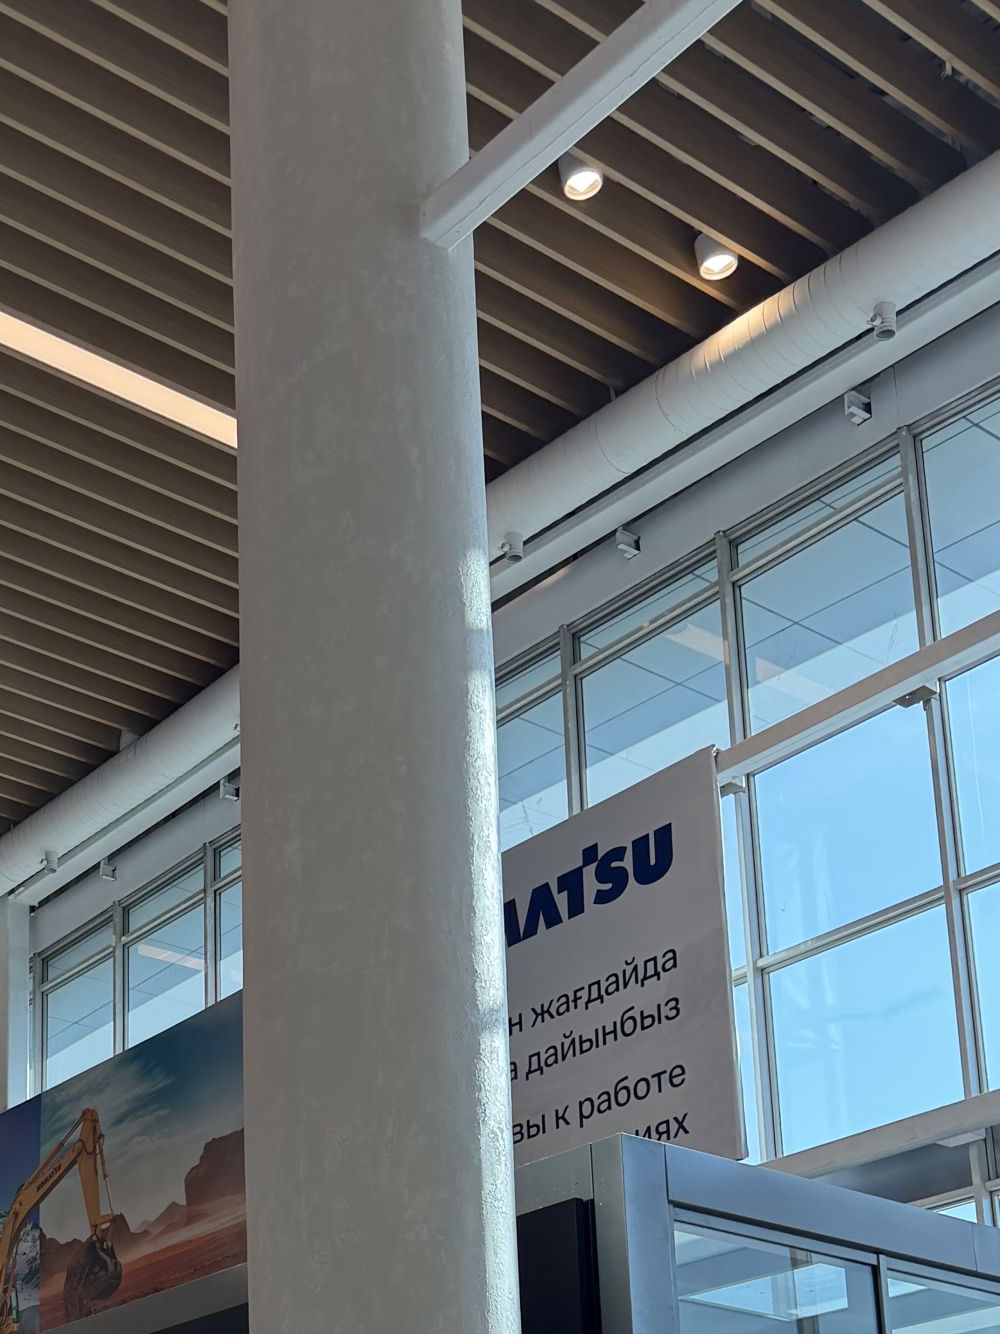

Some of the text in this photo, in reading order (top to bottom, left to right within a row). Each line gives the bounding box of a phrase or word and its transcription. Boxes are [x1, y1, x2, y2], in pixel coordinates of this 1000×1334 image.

[531, 948, 679, 1027] жағдайда
[526, 997, 682, 1081] дайынбыз
[555, 1103, 571, 1130] к
[578, 1064, 687, 1129] работе
